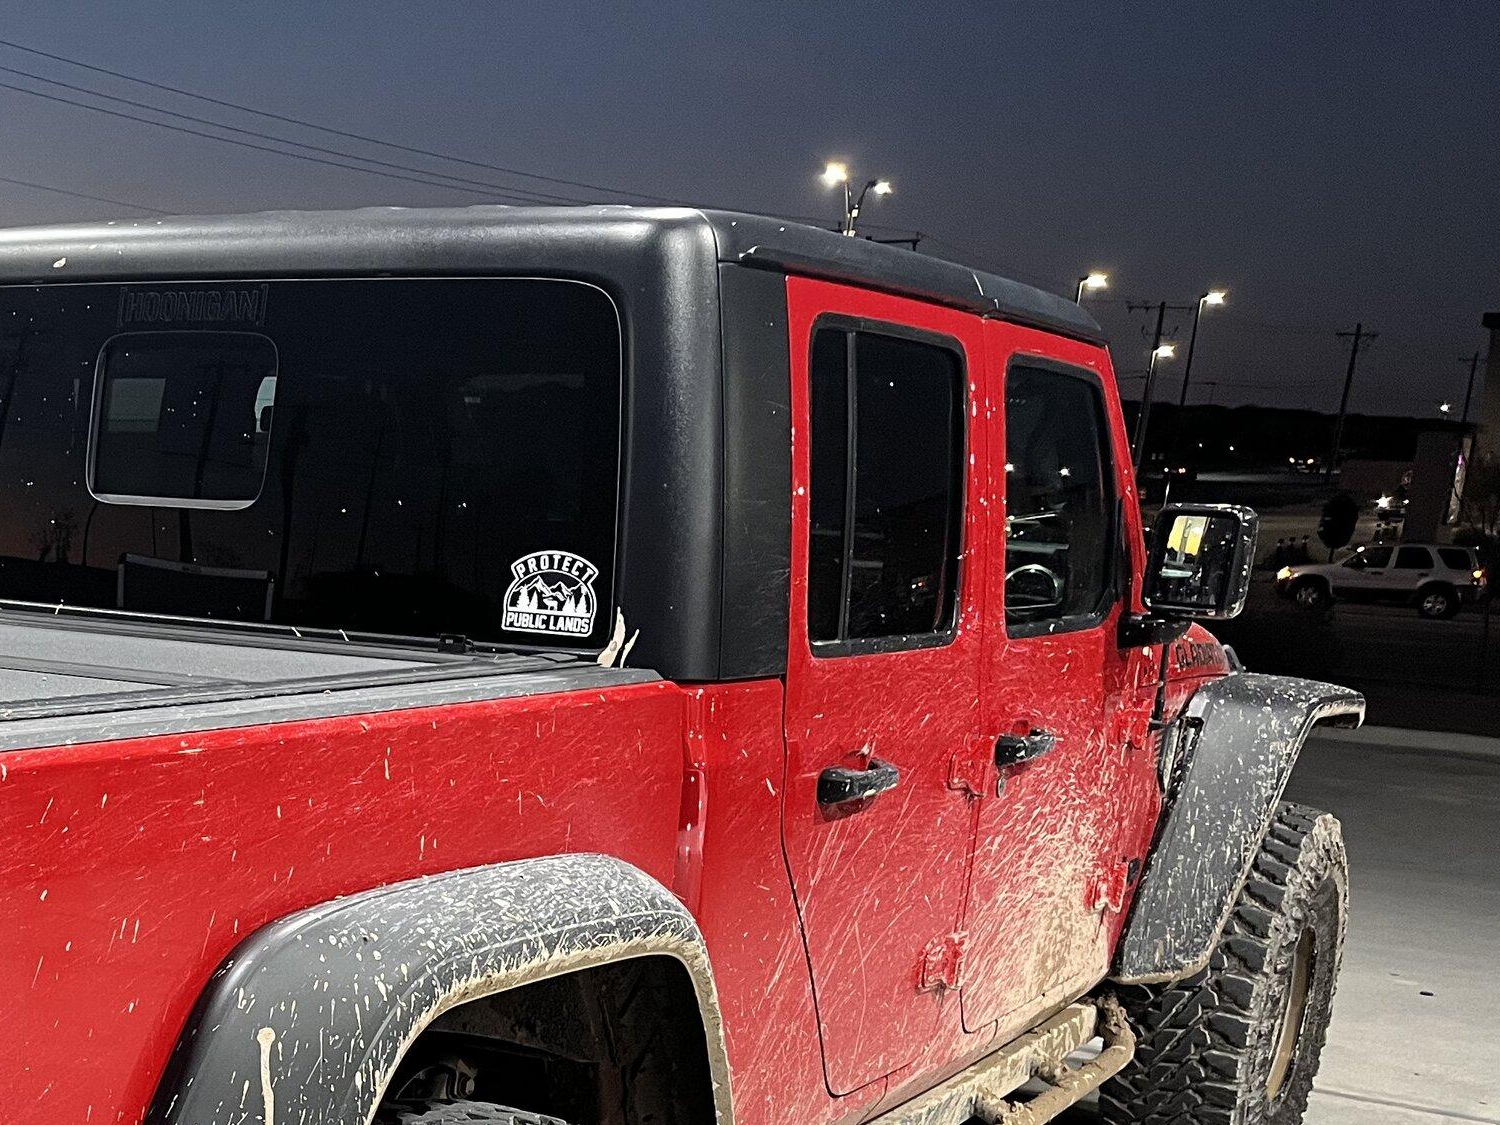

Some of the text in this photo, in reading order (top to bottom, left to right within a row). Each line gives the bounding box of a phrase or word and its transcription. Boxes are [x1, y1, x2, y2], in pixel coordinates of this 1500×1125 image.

[515, 554, 595, 582] PROTECT
[506, 612, 590, 633] PUBLIC LANDS
